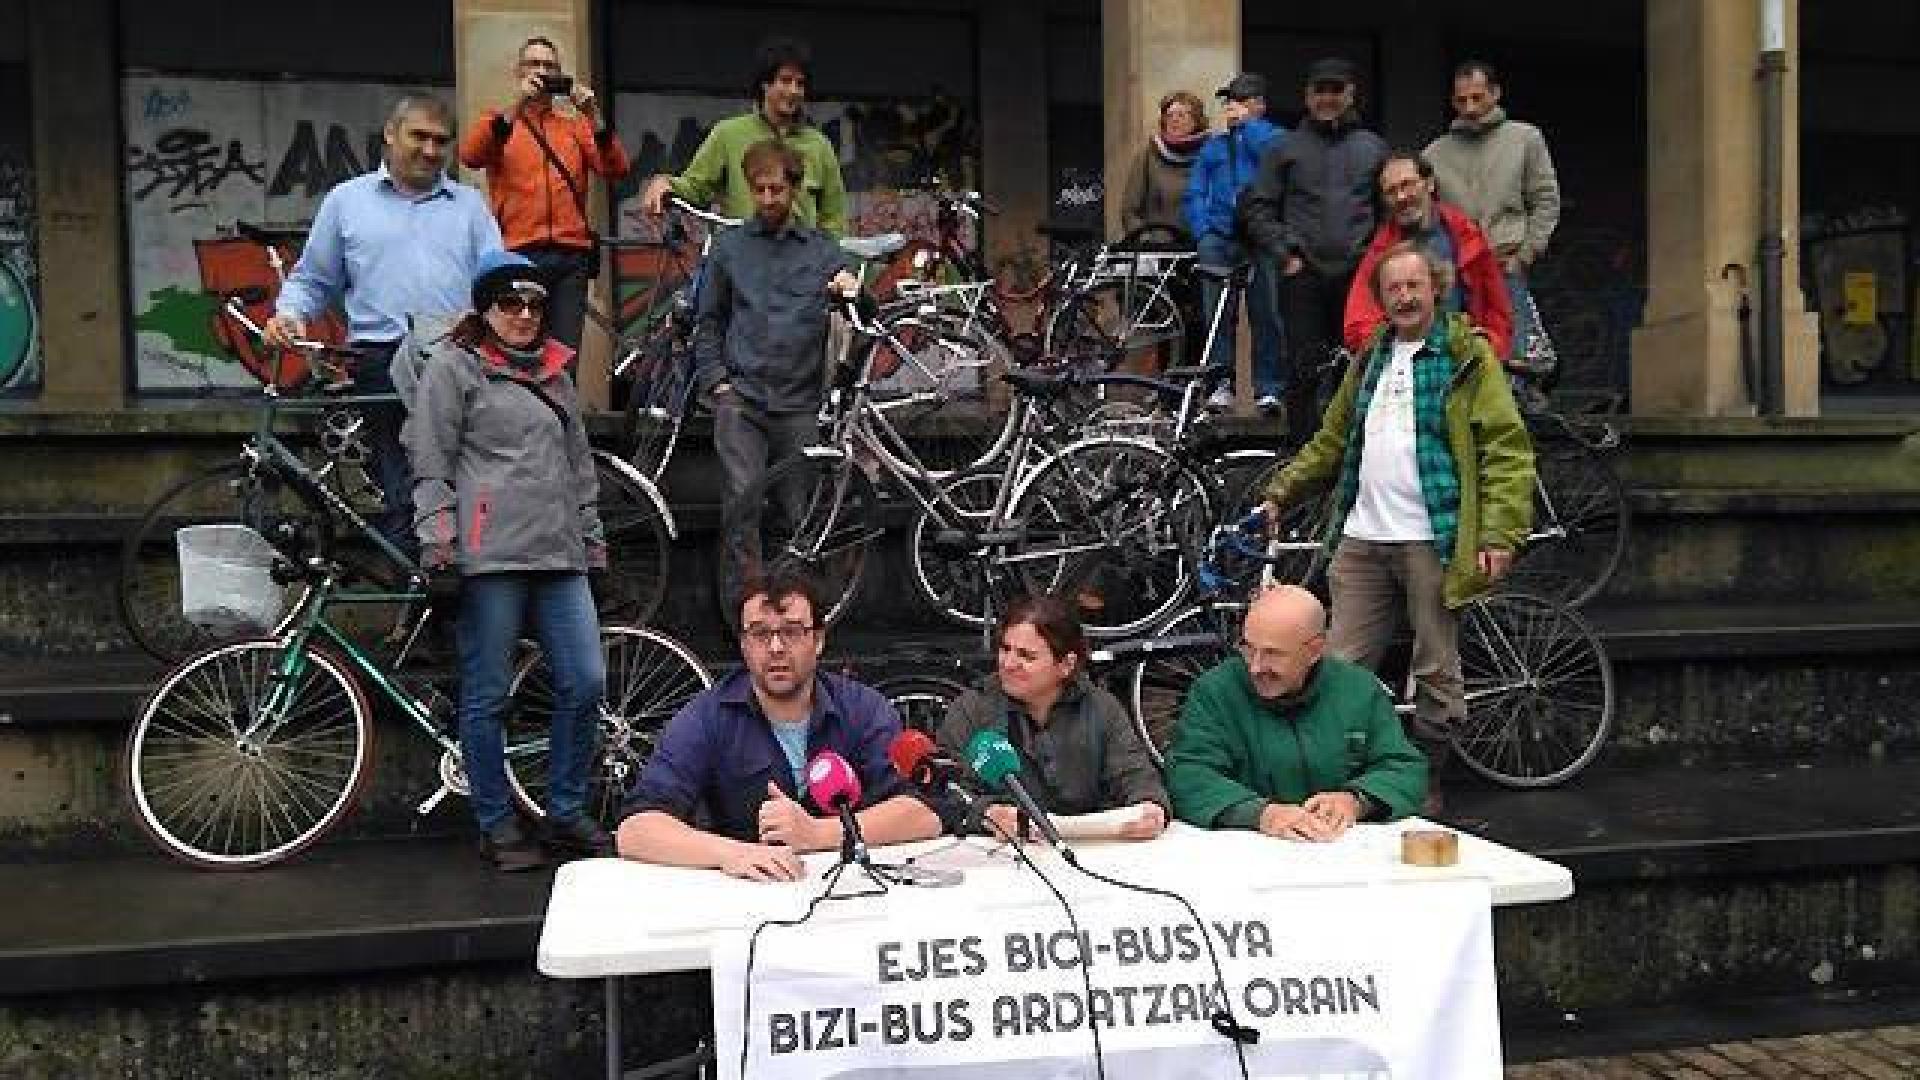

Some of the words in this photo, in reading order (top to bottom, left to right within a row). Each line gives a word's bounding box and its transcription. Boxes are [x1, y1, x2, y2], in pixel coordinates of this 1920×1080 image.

[878, 935, 987, 983] EJES
[1004, 924, 1200, 973] BICI-BUS
[1212, 920, 1273, 958] YA
[769, 998, 974, 1056] BIZI-BUS
[993, 983, 1228, 1037] ARDATZAK
[1243, 974, 1380, 1018] ORAIN
